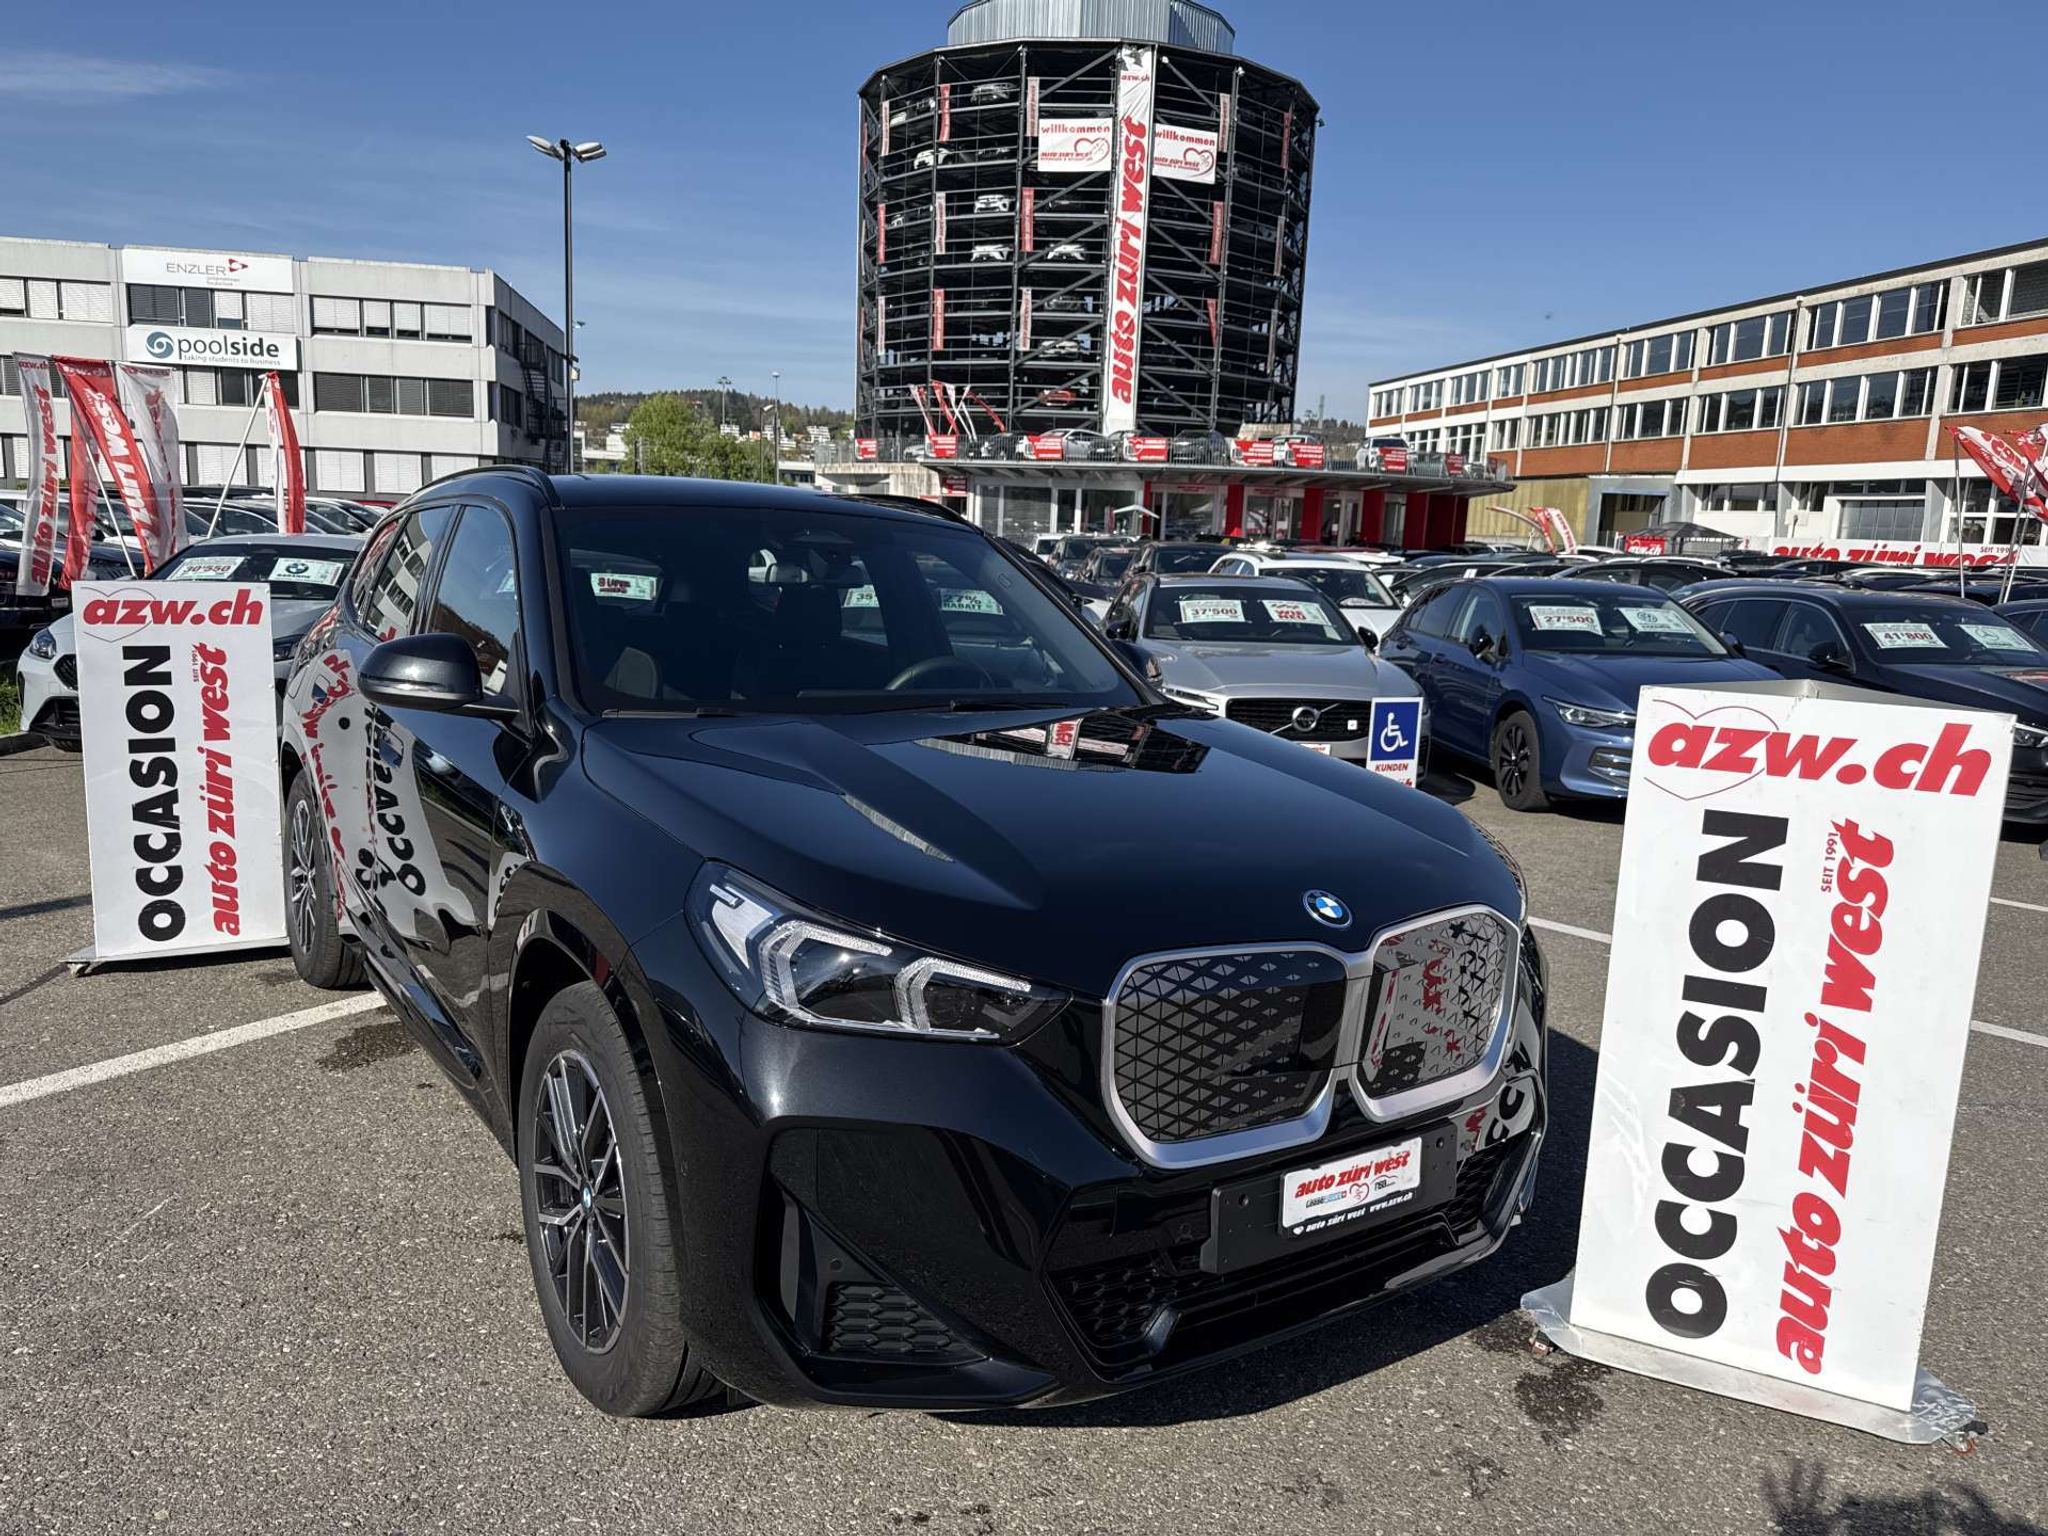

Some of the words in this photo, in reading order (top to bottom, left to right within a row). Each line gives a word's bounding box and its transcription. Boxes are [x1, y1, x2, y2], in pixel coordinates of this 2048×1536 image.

[1041, 124, 1110, 133] willkommen
[1121, 115, 1147, 212] west
[166, 263, 226, 275] ENZLER
[178, 335, 279, 360] poolside
[184, 354, 206, 363] taking
[208, 356, 239, 364] students
[250, 358, 281, 366] business
[1111, 310, 1136, 404] auto
[34, 384, 57, 455] west
[31, 523, 52, 586] auto
[83, 589, 264, 626] azw.ch
[1191, 608, 1238, 616] 37'500
[1544, 615, 1595, 624] 27'500
[191, 642, 231, 742] west
[1375, 763, 1409, 772] KUNDEN
[1647, 722, 1993, 798] azw.ch
[122, 645, 185, 942] OCCASION
[197, 746, 237, 839] züri
[1825, 832, 1839, 861] 1991
[204, 841, 240, 937] auto
[1820, 866, 1835, 893] SEIT
[1821, 817, 1894, 1013] west
[1645, 808, 1789, 1340] OCCASION
[1792, 1012, 1867, 1198] züri
[1295, 1174, 1336, 1198] auto
[1336, 1161, 1374, 1187] züri
[1374, 1150, 1410, 1175] west
[1306, 1222, 1325, 1232] auto
[1347, 1208, 1366, 1219] west
[1369, 1191, 1413, 1213] www.azw.ch
[1776, 1199, 1842, 1375] auto
